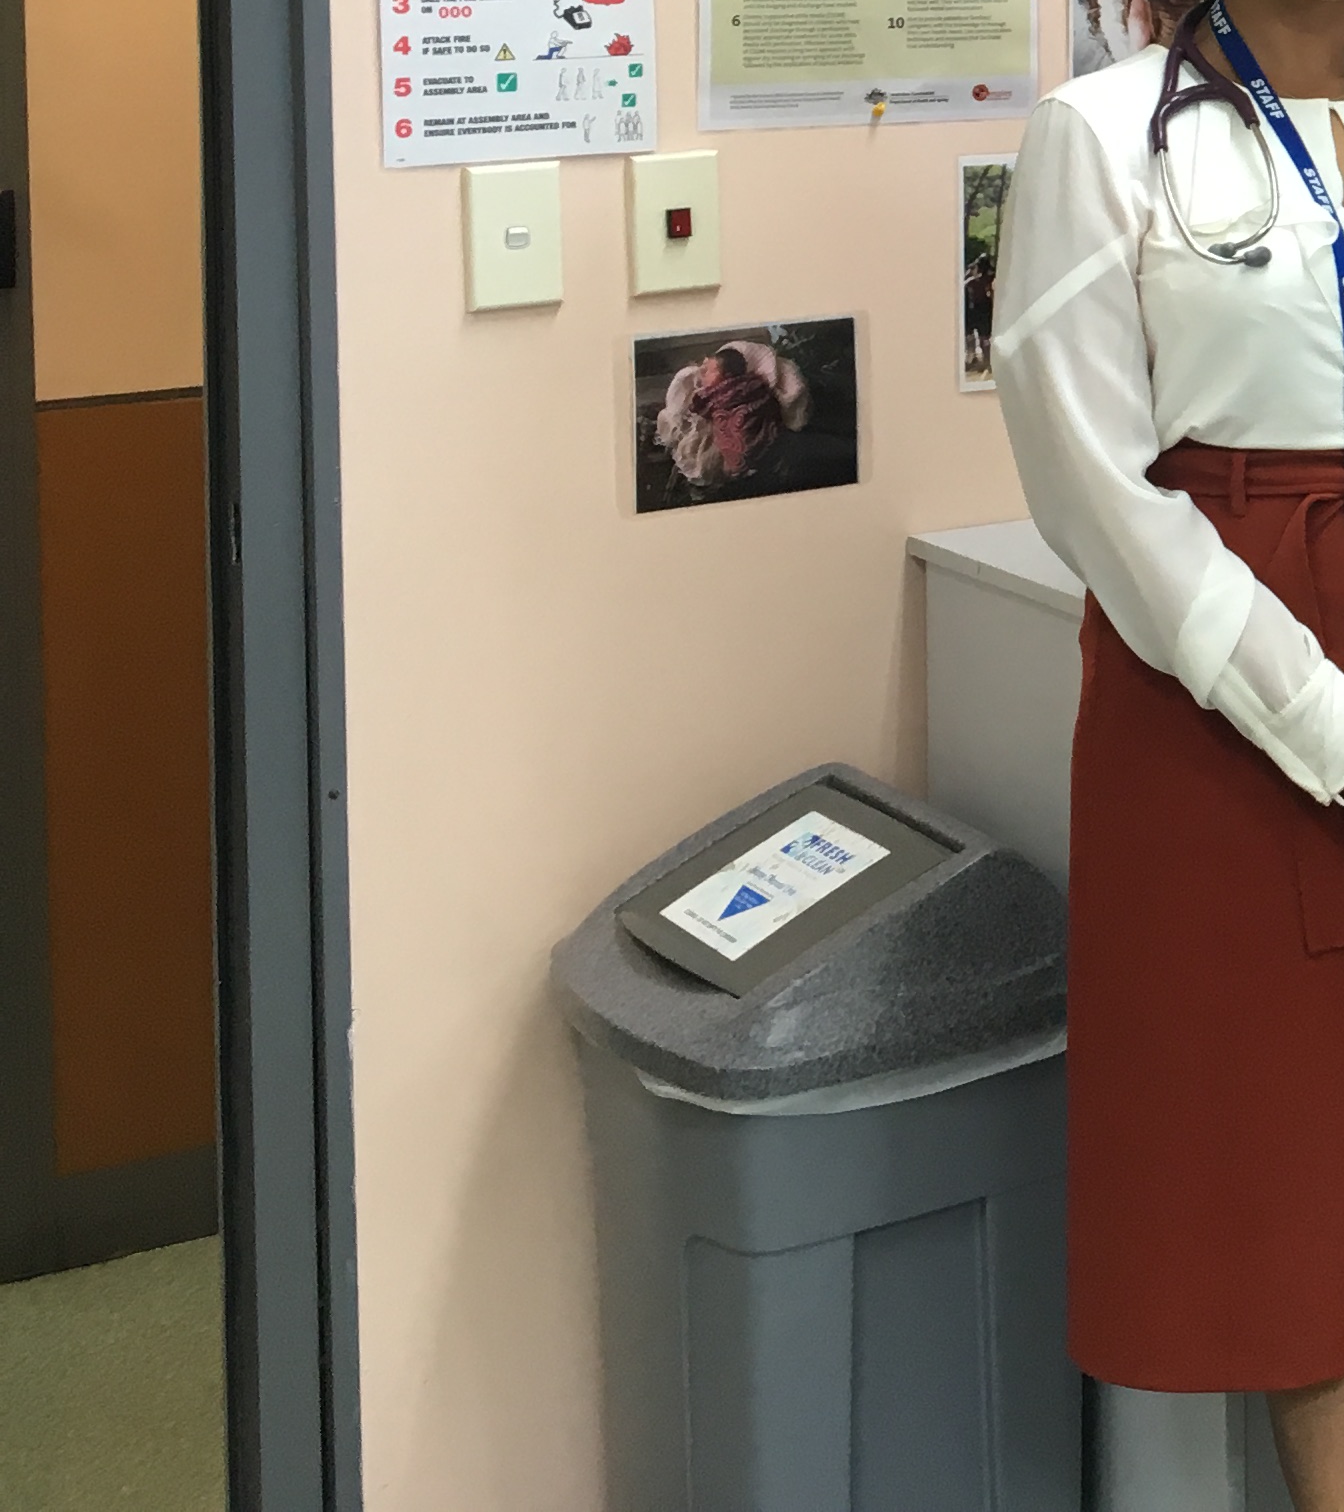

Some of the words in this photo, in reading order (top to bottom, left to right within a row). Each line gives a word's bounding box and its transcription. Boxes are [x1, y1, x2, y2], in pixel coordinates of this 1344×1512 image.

[438, 5, 472, 18] 000
[1211, 0, 1231, 35] TAFF
[731, 16, 741, 28] 6
[887, 18, 905, 29] 10
[393, 36, 411, 55] 4
[393, 77, 412, 97] 5
[1251, 78, 1284, 119] STAFF
[395, 118, 412, 138] 6
[1302, 167, 1334, 215] STAFF
[810, 838, 856, 865] FRESH
